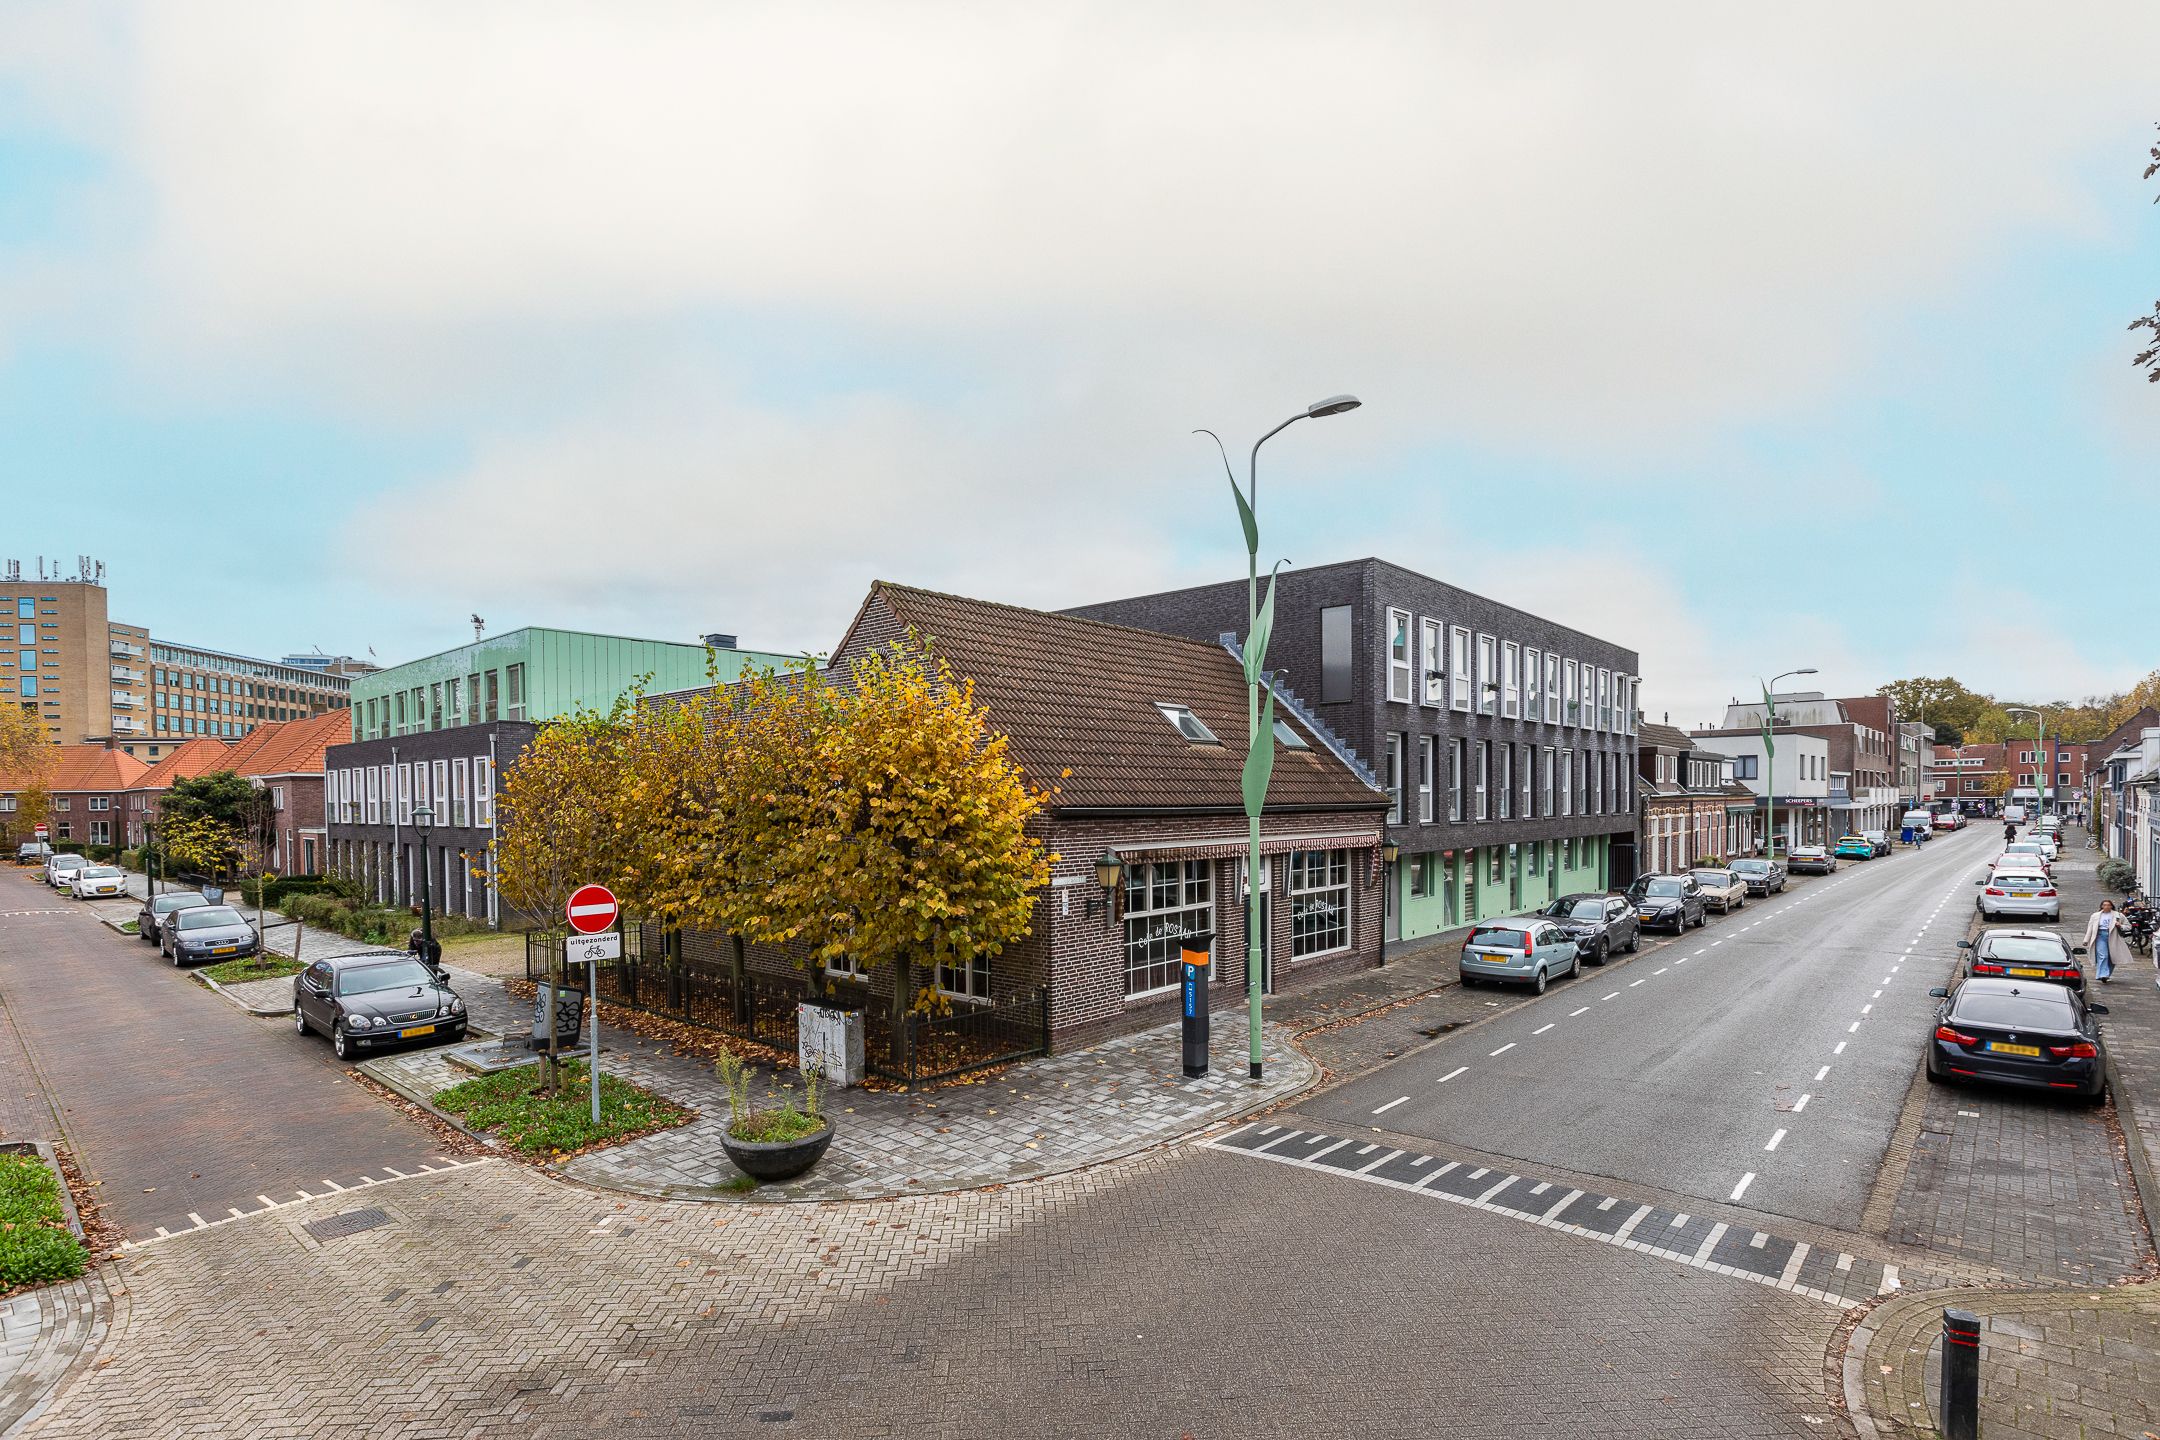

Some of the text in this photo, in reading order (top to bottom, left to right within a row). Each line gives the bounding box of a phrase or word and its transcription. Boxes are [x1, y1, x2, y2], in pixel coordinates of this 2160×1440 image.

[1155, 926, 1163, 937] de
[571, 935, 618, 945] uitgezonderd
[1187, 965, 1195, 977] P
